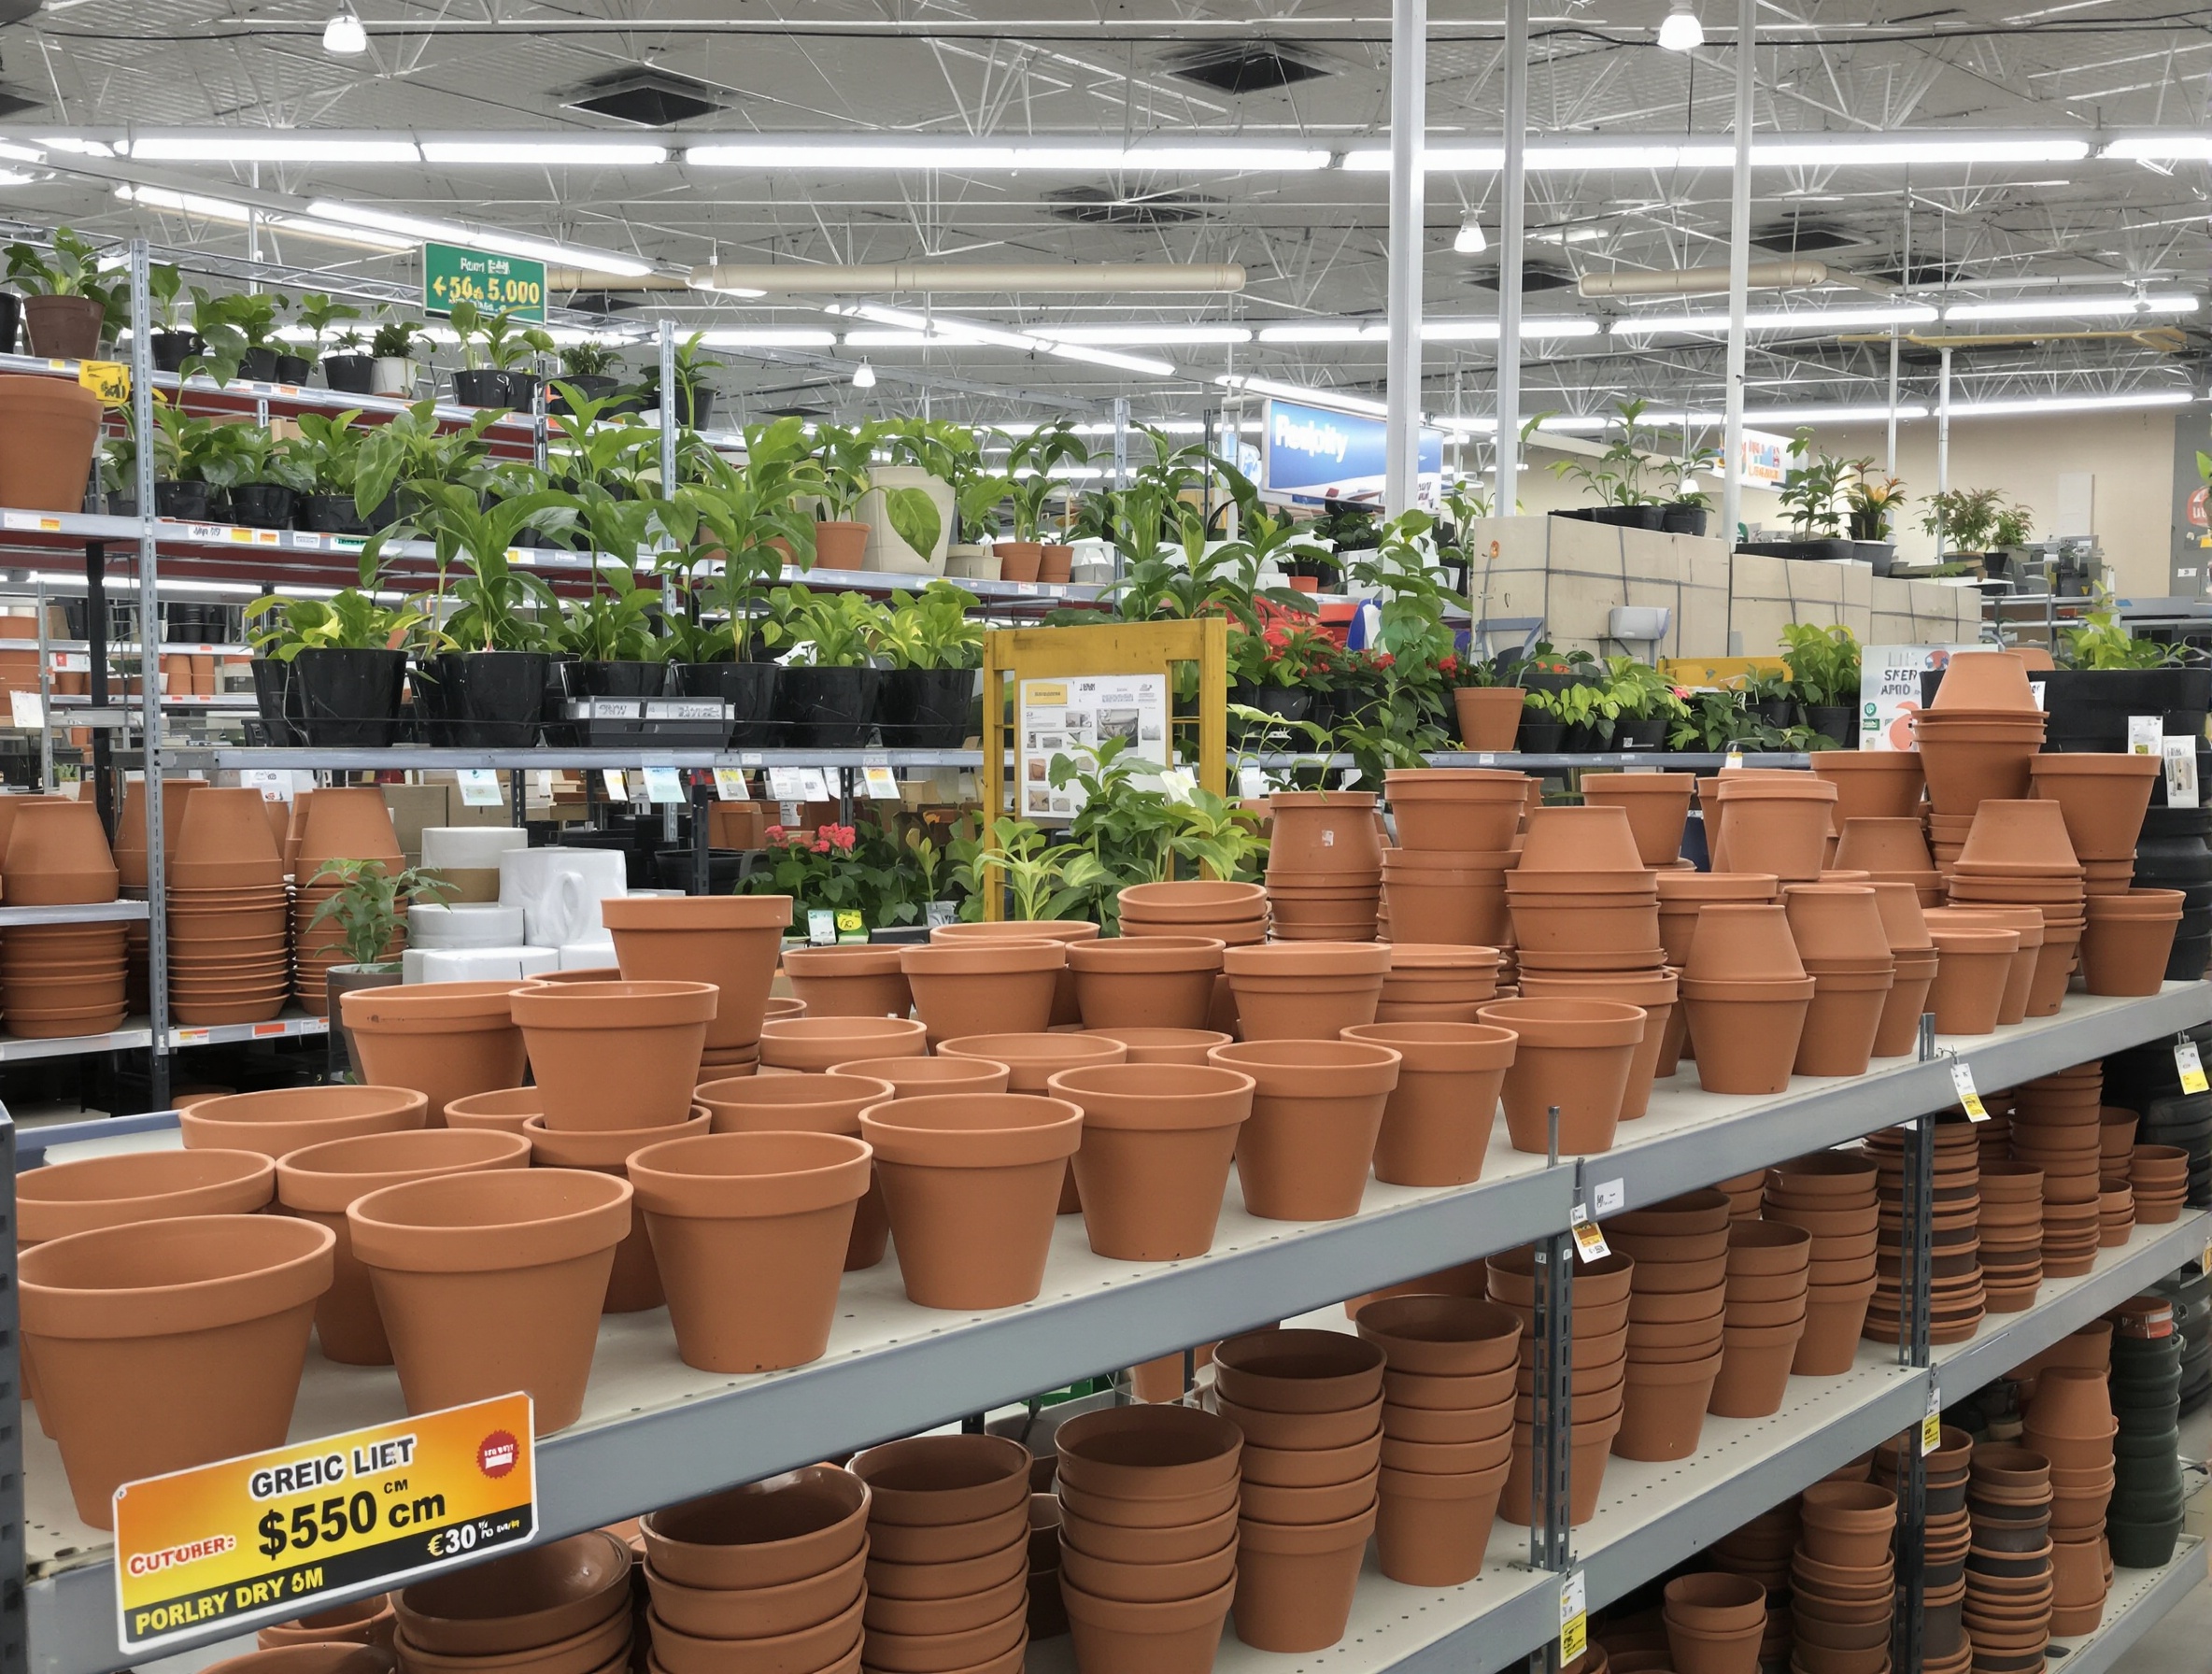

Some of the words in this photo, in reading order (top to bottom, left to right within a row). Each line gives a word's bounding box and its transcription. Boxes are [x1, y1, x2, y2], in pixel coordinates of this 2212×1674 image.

[250, 1454, 345, 1498] GREIC
[258, 1491, 377, 1561] $550
[388, 1495, 446, 1528] cm
[427, 1524, 476, 1556] €30
[235, 1576, 286, 1609] DRY
